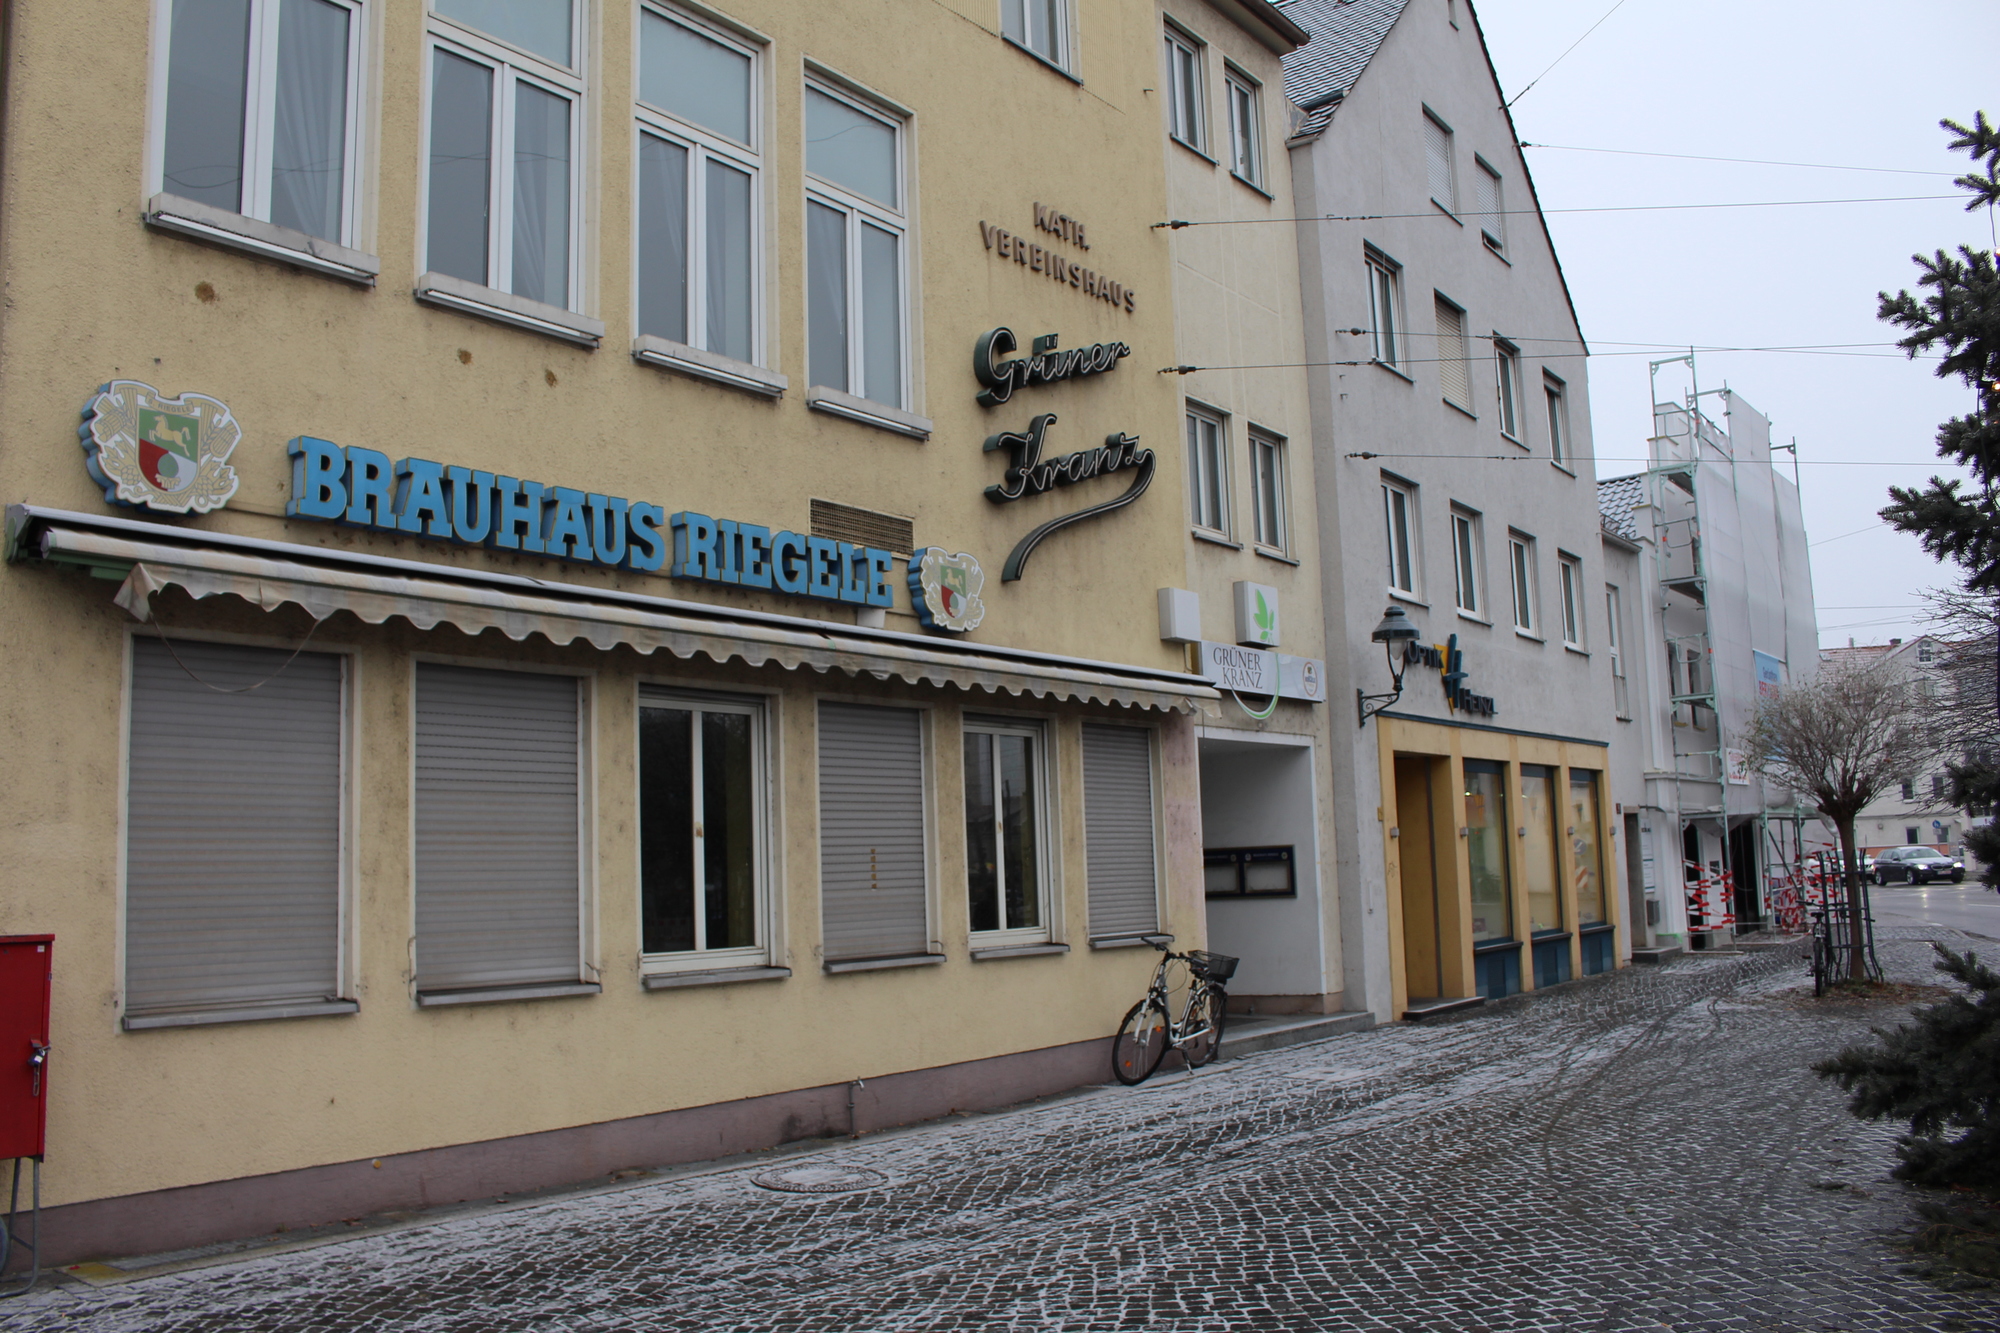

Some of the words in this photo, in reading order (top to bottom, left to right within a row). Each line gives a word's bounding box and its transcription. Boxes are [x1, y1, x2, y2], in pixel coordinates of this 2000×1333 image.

[979, 220, 1137, 313] VEREINSHAUS
[1033, 201, 1091, 250] KATH.
[974, 326, 1131, 408] Grüner
[983, 412, 1156, 505] Kranz
[287, 435, 665, 573] BRAUHAUS
[671, 511, 893, 608] RIEGELE
[1213, 646, 1262, 671] GRÜNER
[1222, 667, 1263, 690] KRANZ
